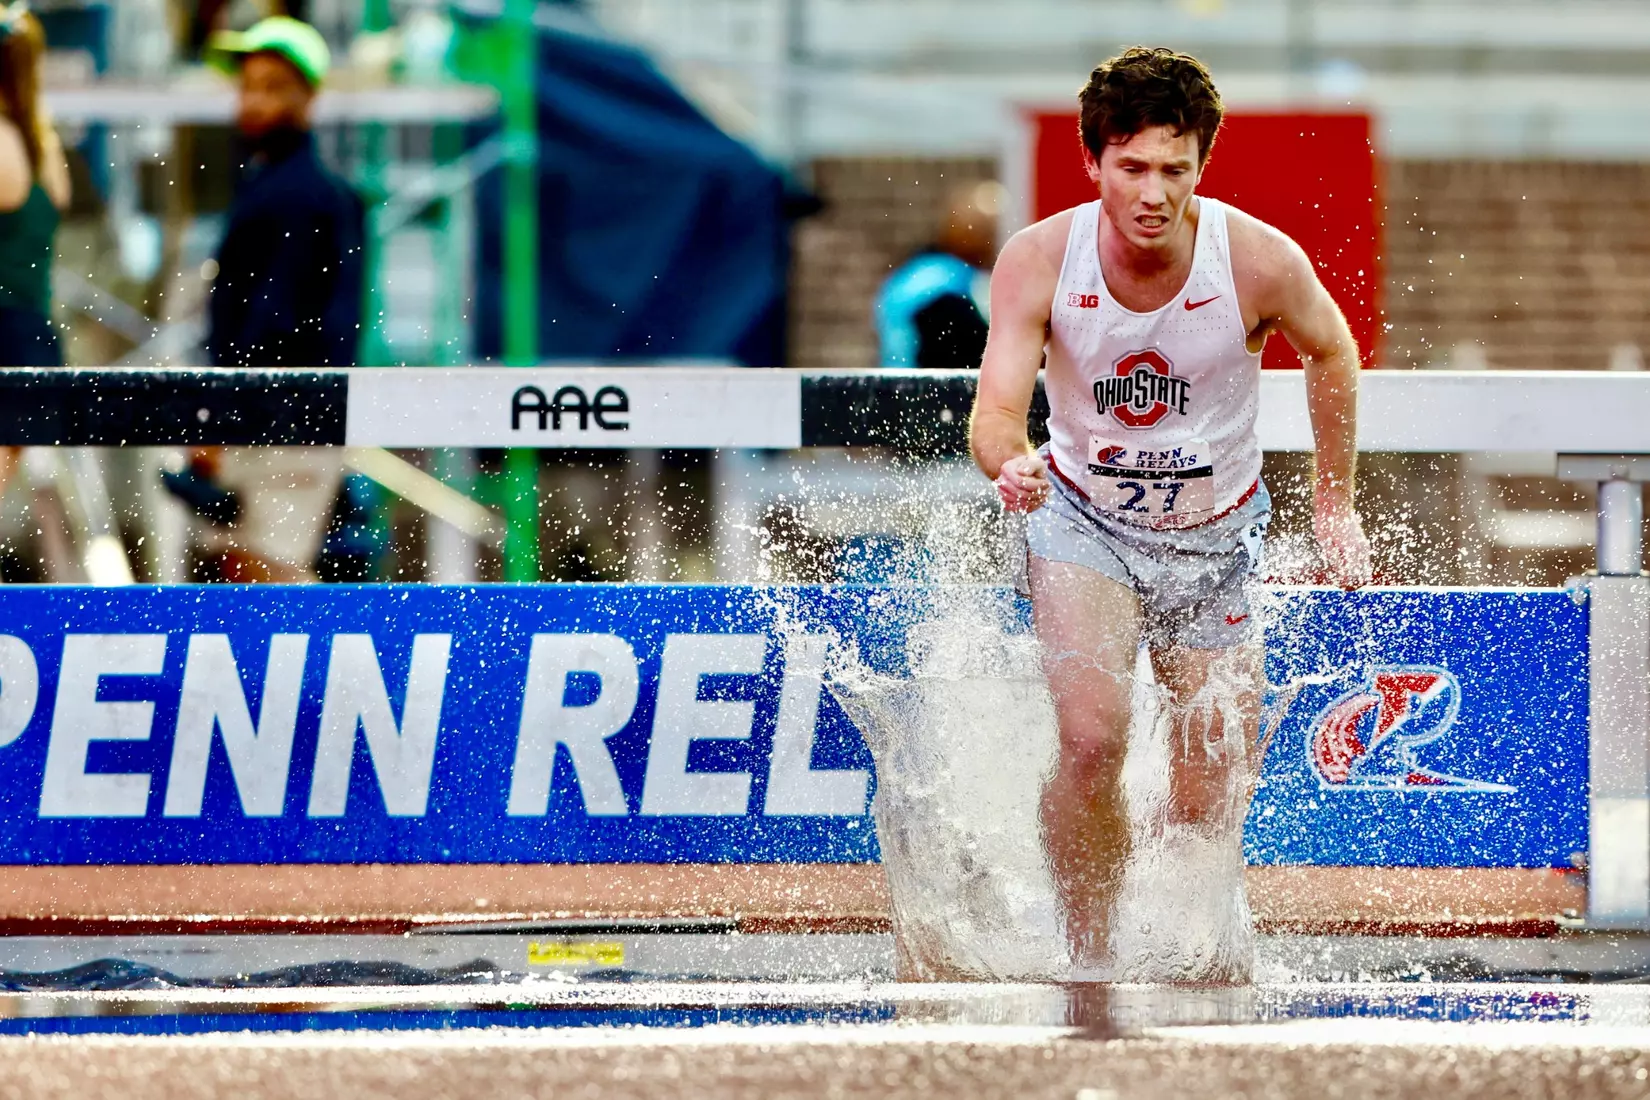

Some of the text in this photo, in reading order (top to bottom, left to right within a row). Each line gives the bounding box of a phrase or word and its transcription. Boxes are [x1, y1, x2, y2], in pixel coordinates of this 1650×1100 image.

[1136, 446, 1183, 460] PENN
[1134, 454, 1197, 469] RELAYS
[1116, 481, 1185, 513] 27
